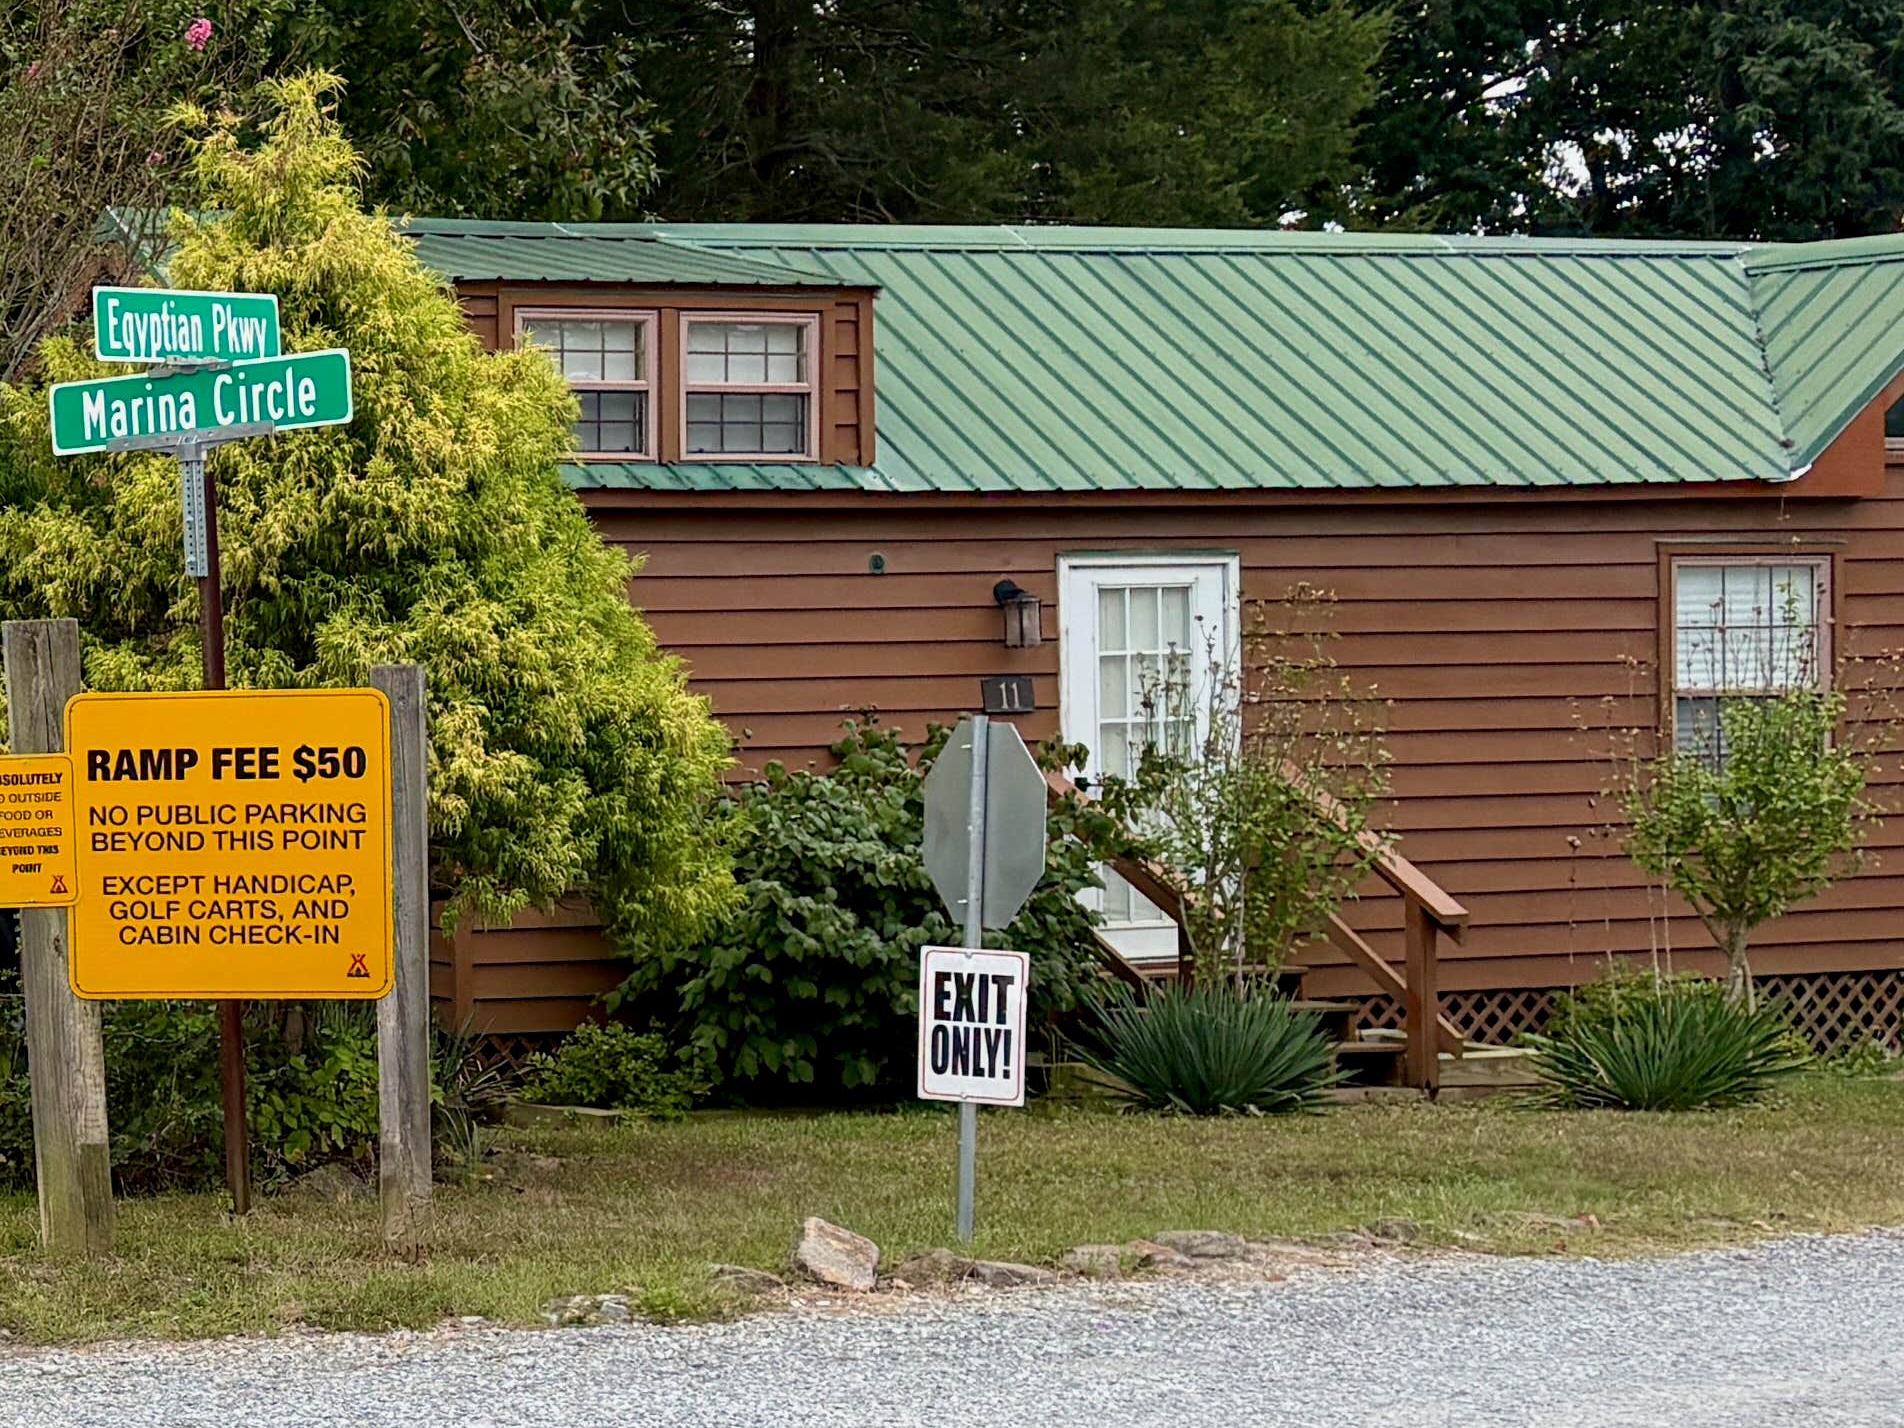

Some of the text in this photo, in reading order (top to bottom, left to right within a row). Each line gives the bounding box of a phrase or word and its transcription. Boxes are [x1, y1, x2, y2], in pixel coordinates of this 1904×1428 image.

[107, 297, 267, 359] Egyptian Pkwy
[82, 367, 317, 440] Marina Circle
[999, 682, 1020, 709] 11
[87, 744, 366, 783] RAMP FEE $50
[9, 792, 62, 803] OUTSIDE
[35, 810, 53, 820] OR
[89, 803, 366, 826] NO PUBLIC PARKING
[37, 845, 59, 855] THIS
[92, 829, 366, 851] BEYOND THIS POINT
[12, 863, 42, 873] POINT
[103, 874, 356, 897] EXCEPT HANDICAP,
[110, 900, 349, 922] GOLF CARTS, AND
[119, 924, 339, 945] CABIN CHECK-IN
[933, 971, 1015, 1025] EXIT
[931, 1024, 1012, 1080] ONLY!
